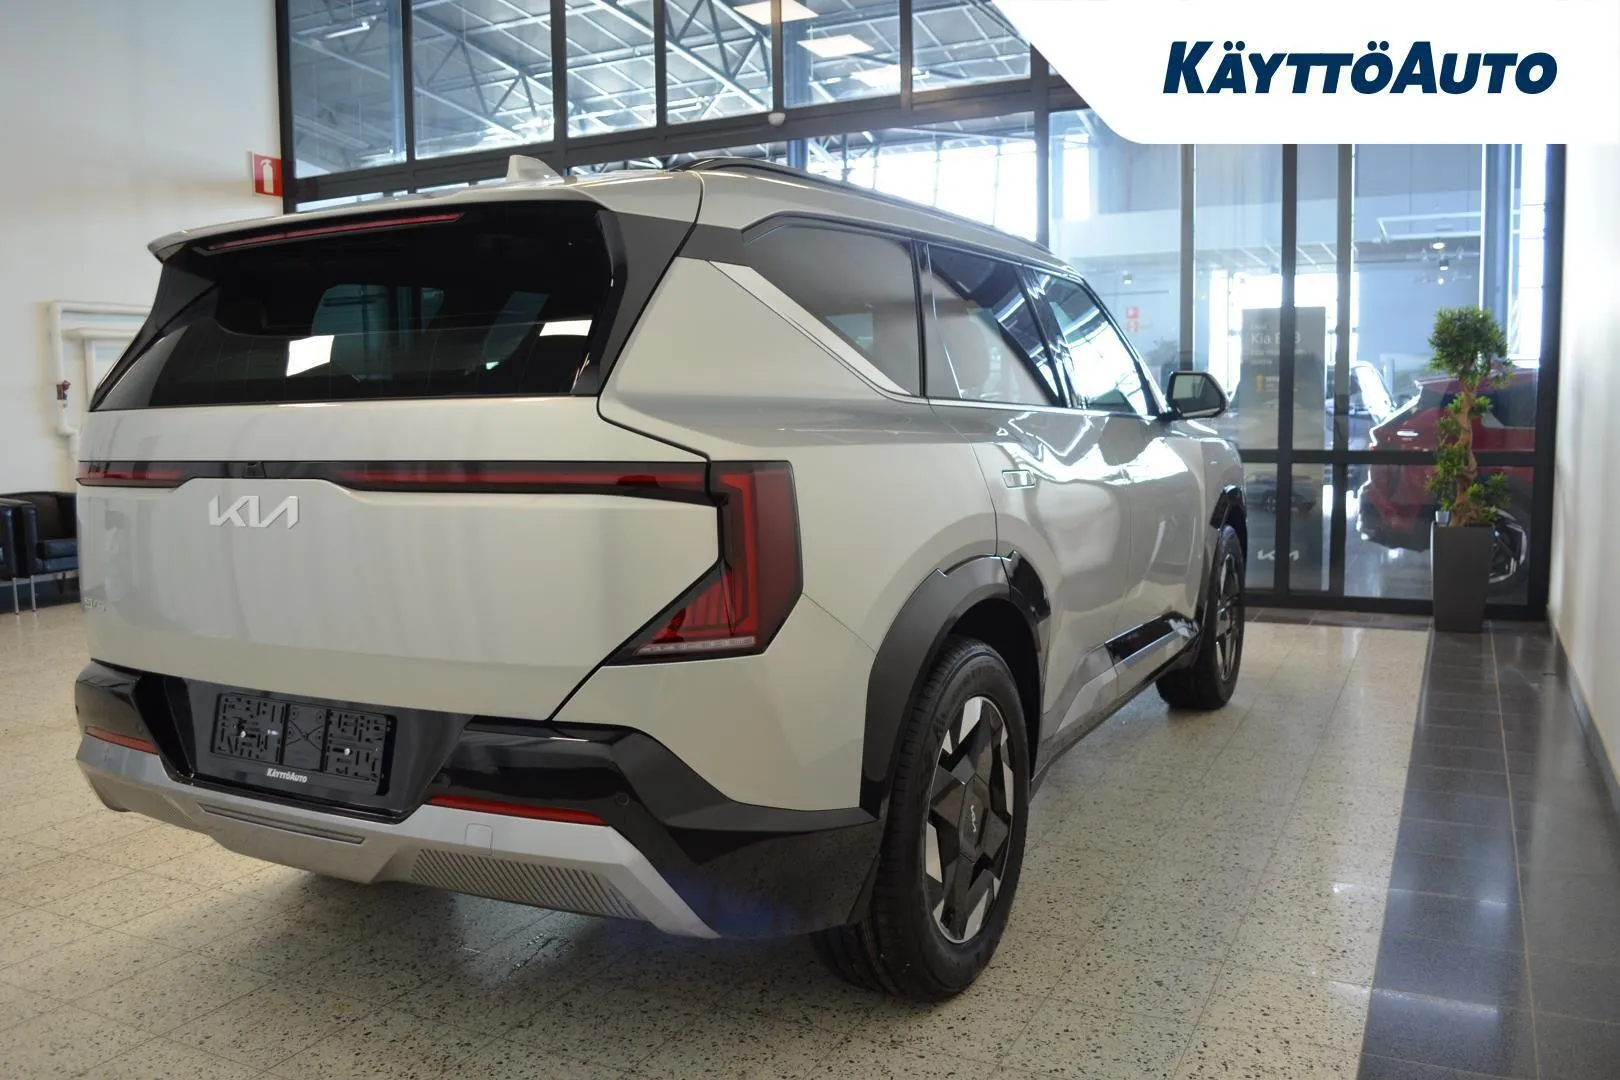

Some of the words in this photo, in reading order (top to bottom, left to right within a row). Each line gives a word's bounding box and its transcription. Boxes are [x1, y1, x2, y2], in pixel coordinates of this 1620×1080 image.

[1251, 332, 1271, 345] Kia
[1275, 331, 1301, 344] E3
[208, 494, 299, 529] KIA
[266, 767, 308, 783] KÄYTTÖAUTO
